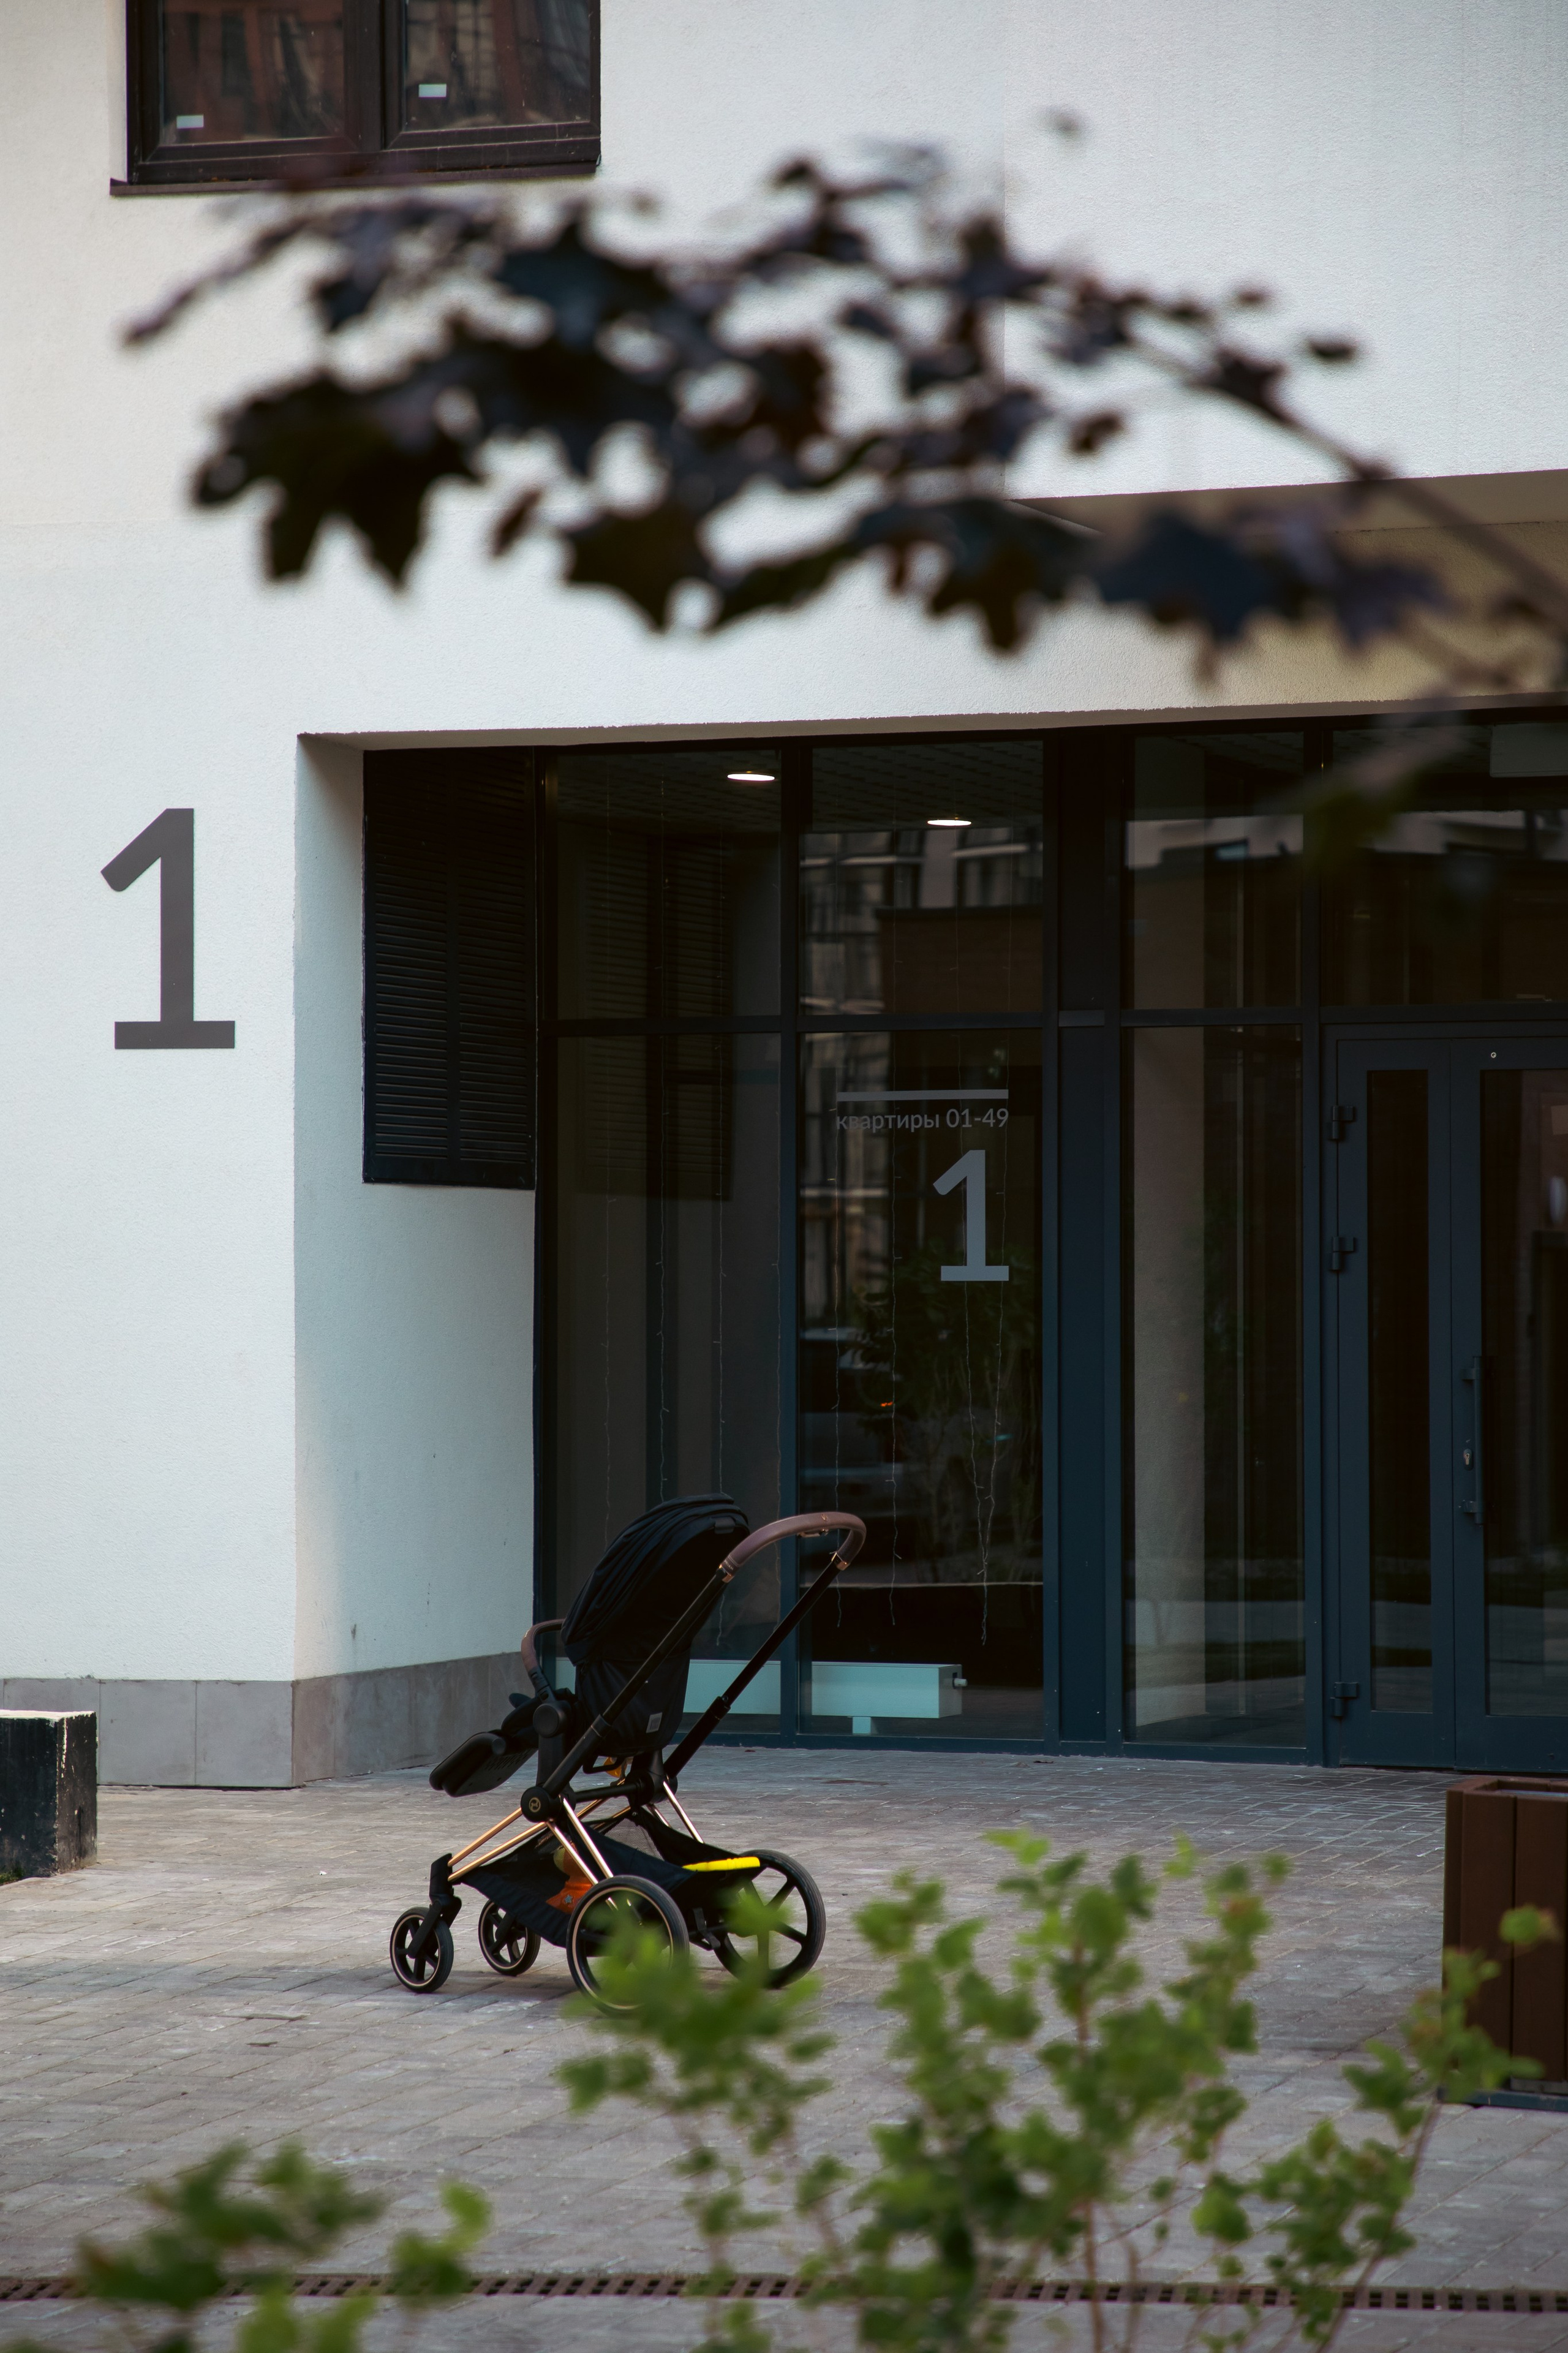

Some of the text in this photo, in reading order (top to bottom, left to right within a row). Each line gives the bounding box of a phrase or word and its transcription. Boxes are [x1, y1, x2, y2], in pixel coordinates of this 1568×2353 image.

[100, 808, 235, 1049] 1
[836, 1108, 1009, 1133] квартиры 01-49
[933, 1150, 1009, 1281] 1
